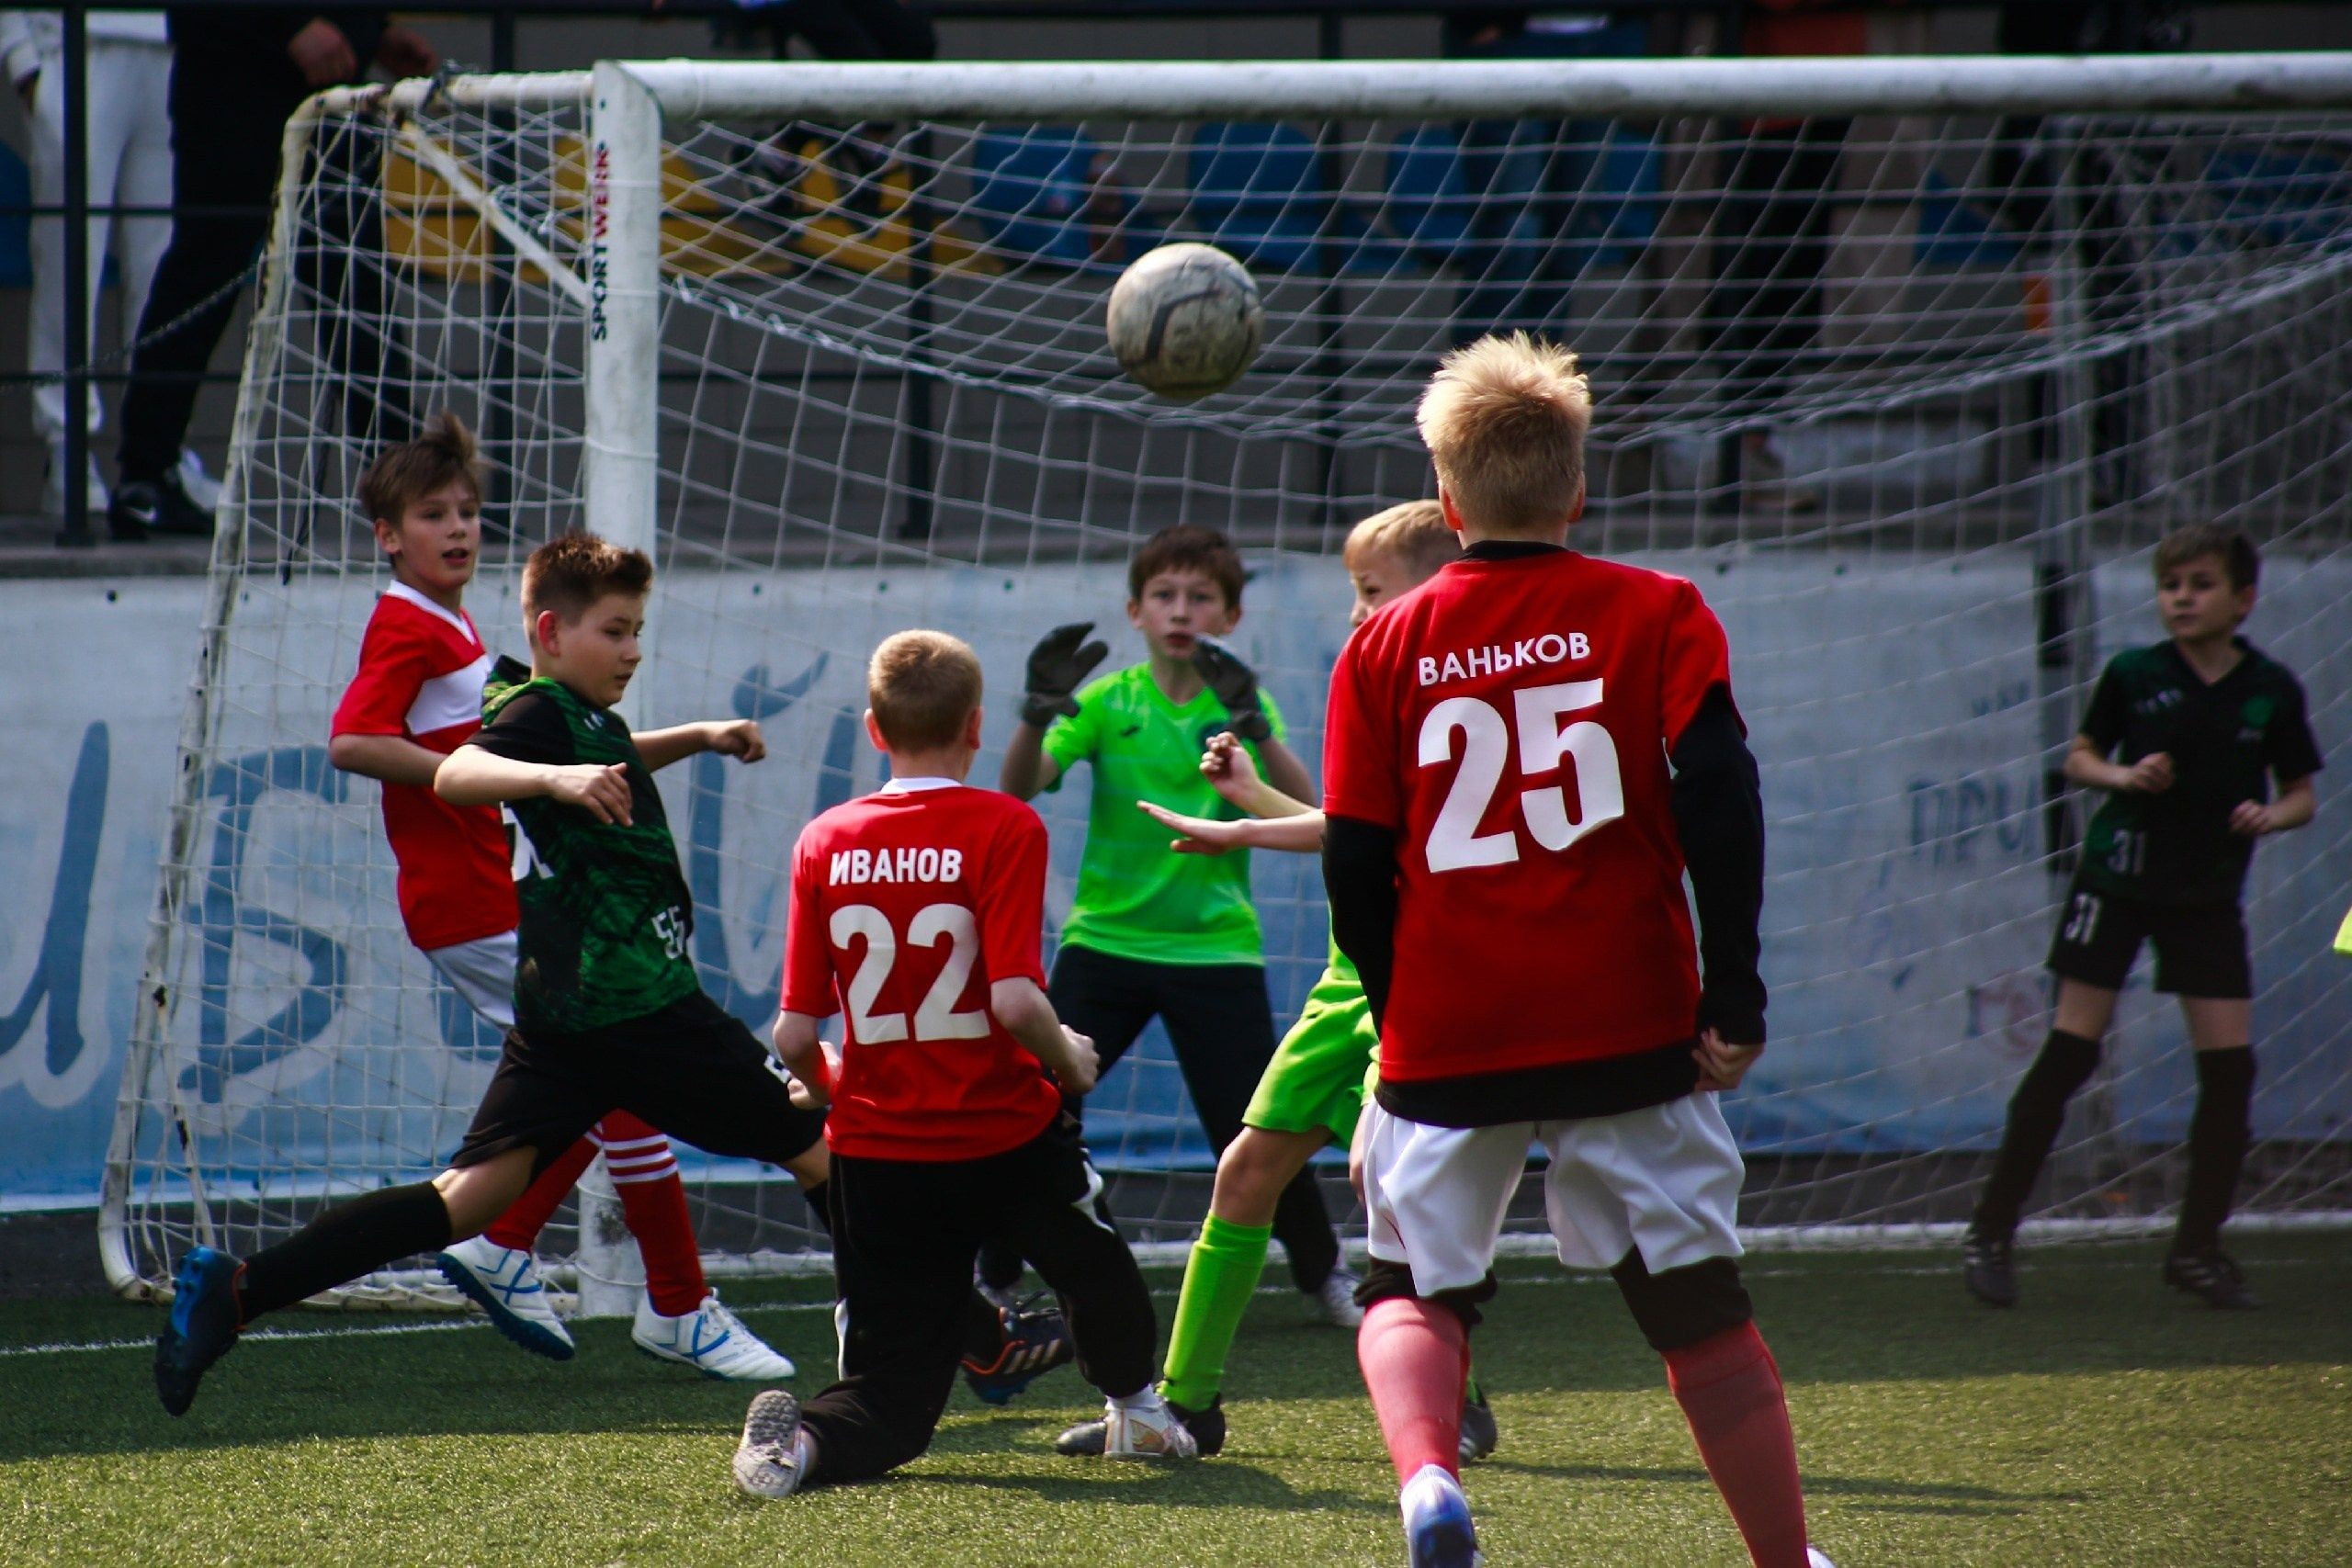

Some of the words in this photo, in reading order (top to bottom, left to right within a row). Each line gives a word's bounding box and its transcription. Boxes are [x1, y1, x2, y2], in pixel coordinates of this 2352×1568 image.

[1419, 632, 1590, 685] ВАНЬКОВ
[1419, 678, 1624, 873] 25
[830, 847, 963, 886] ИВАНОВ
[829, 903, 991, 1045] 22
